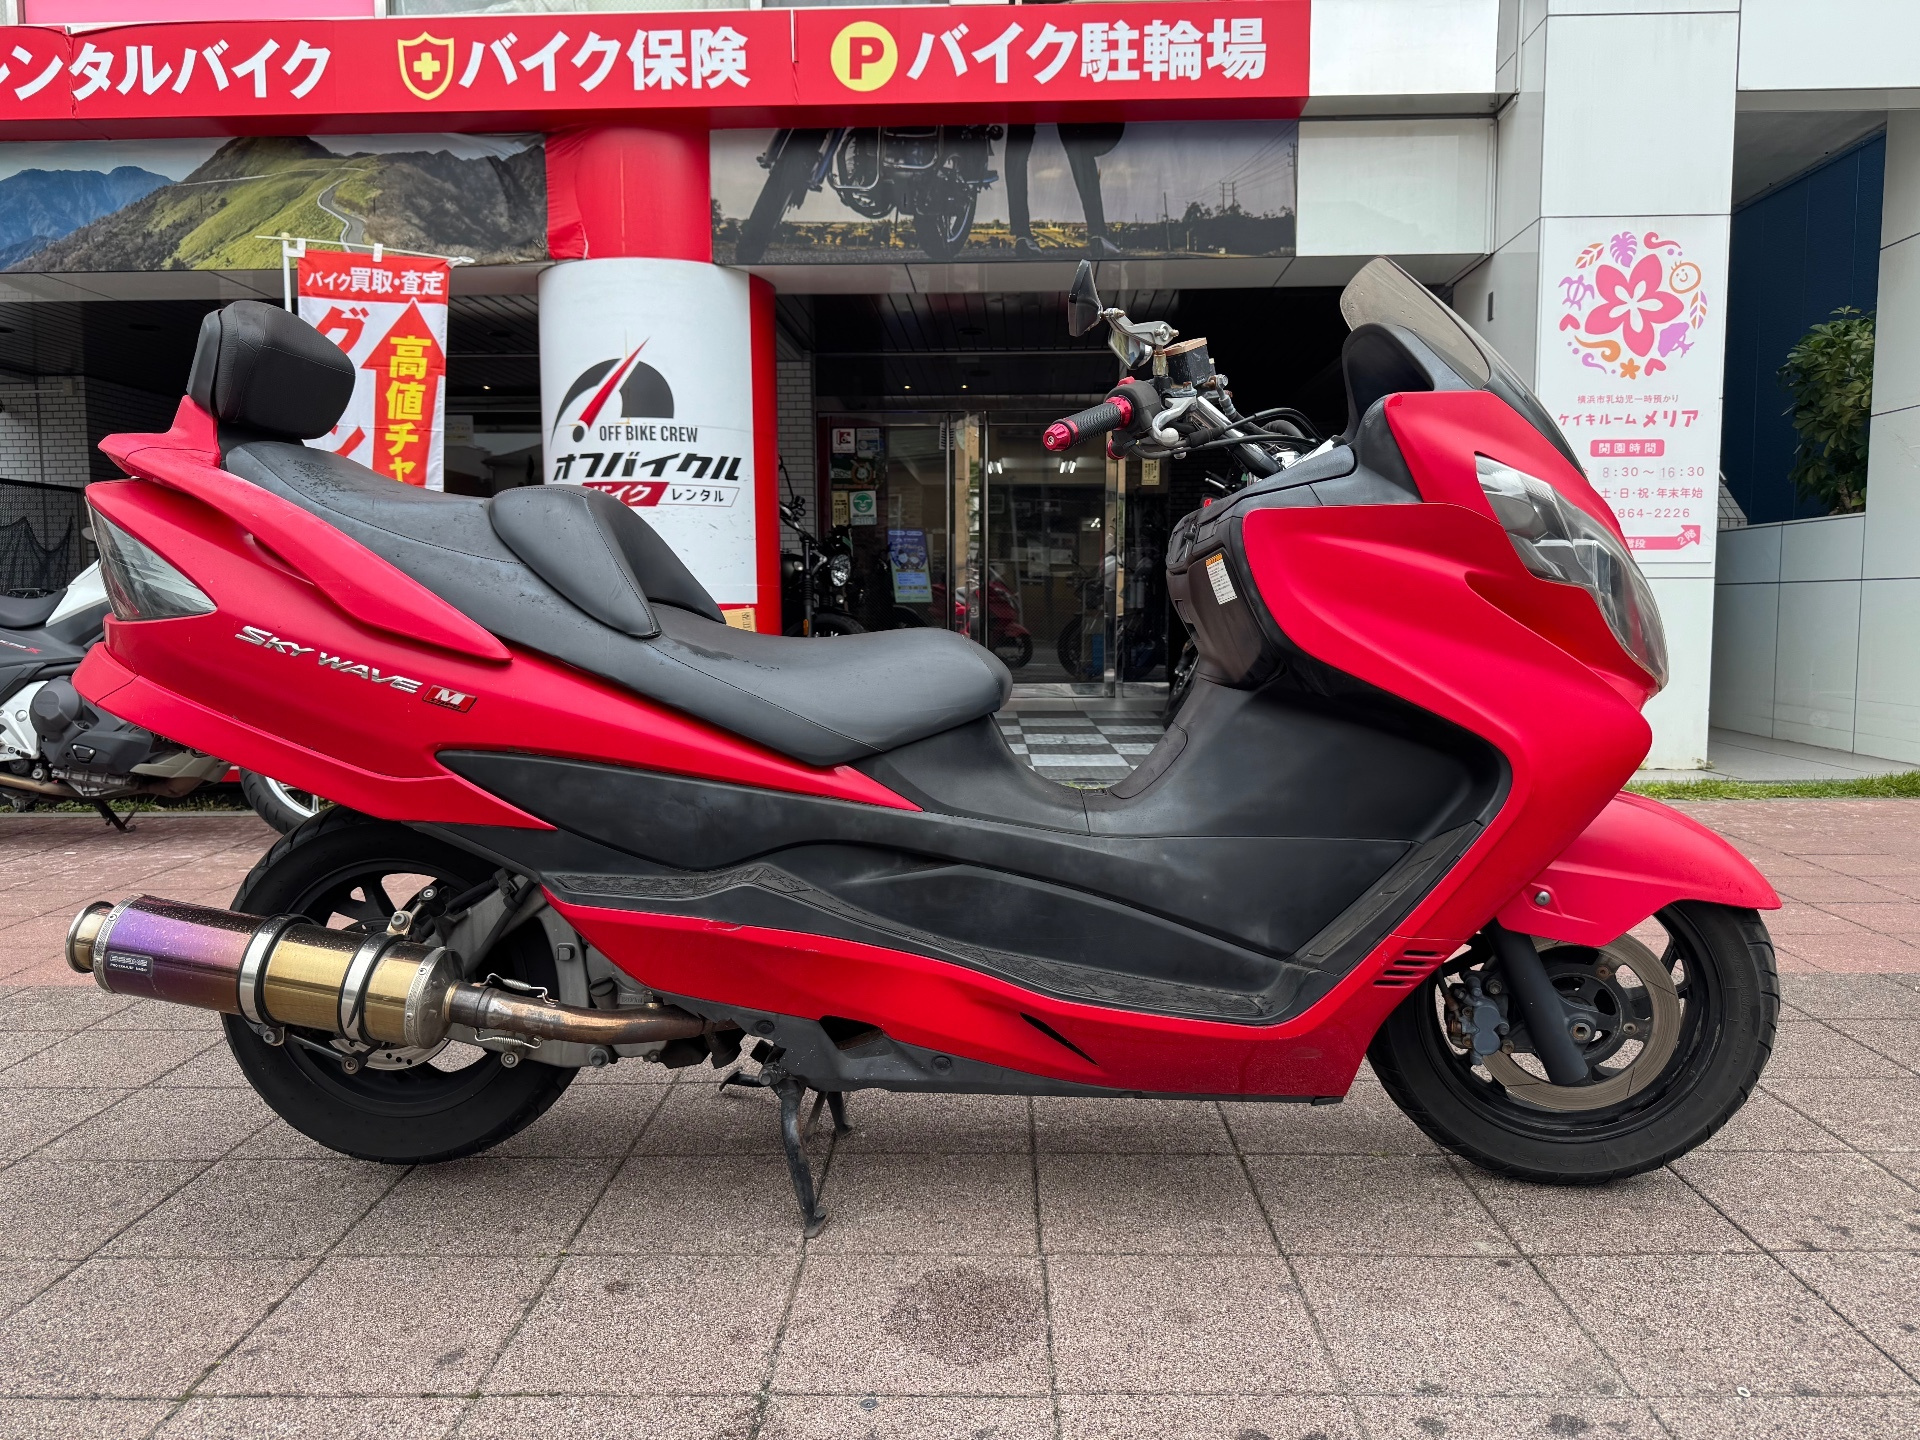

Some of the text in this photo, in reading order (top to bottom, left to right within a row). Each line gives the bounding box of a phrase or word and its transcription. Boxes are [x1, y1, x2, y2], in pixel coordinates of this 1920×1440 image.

[459, 27, 750, 92] バイク保険
[849, 37, 884, 80] P
[907, 17, 1267, 84] バイク駐輪場
[1577, 394, 1679, 404] 横浜市乳幼児一時預かり
[599, 425, 698, 443] OFF BIKE CREW
[1598, 442, 1657, 454] 開園時間
[553, 451, 742, 481] オフバイクル
[672, 488, 724, 503] レンタル
